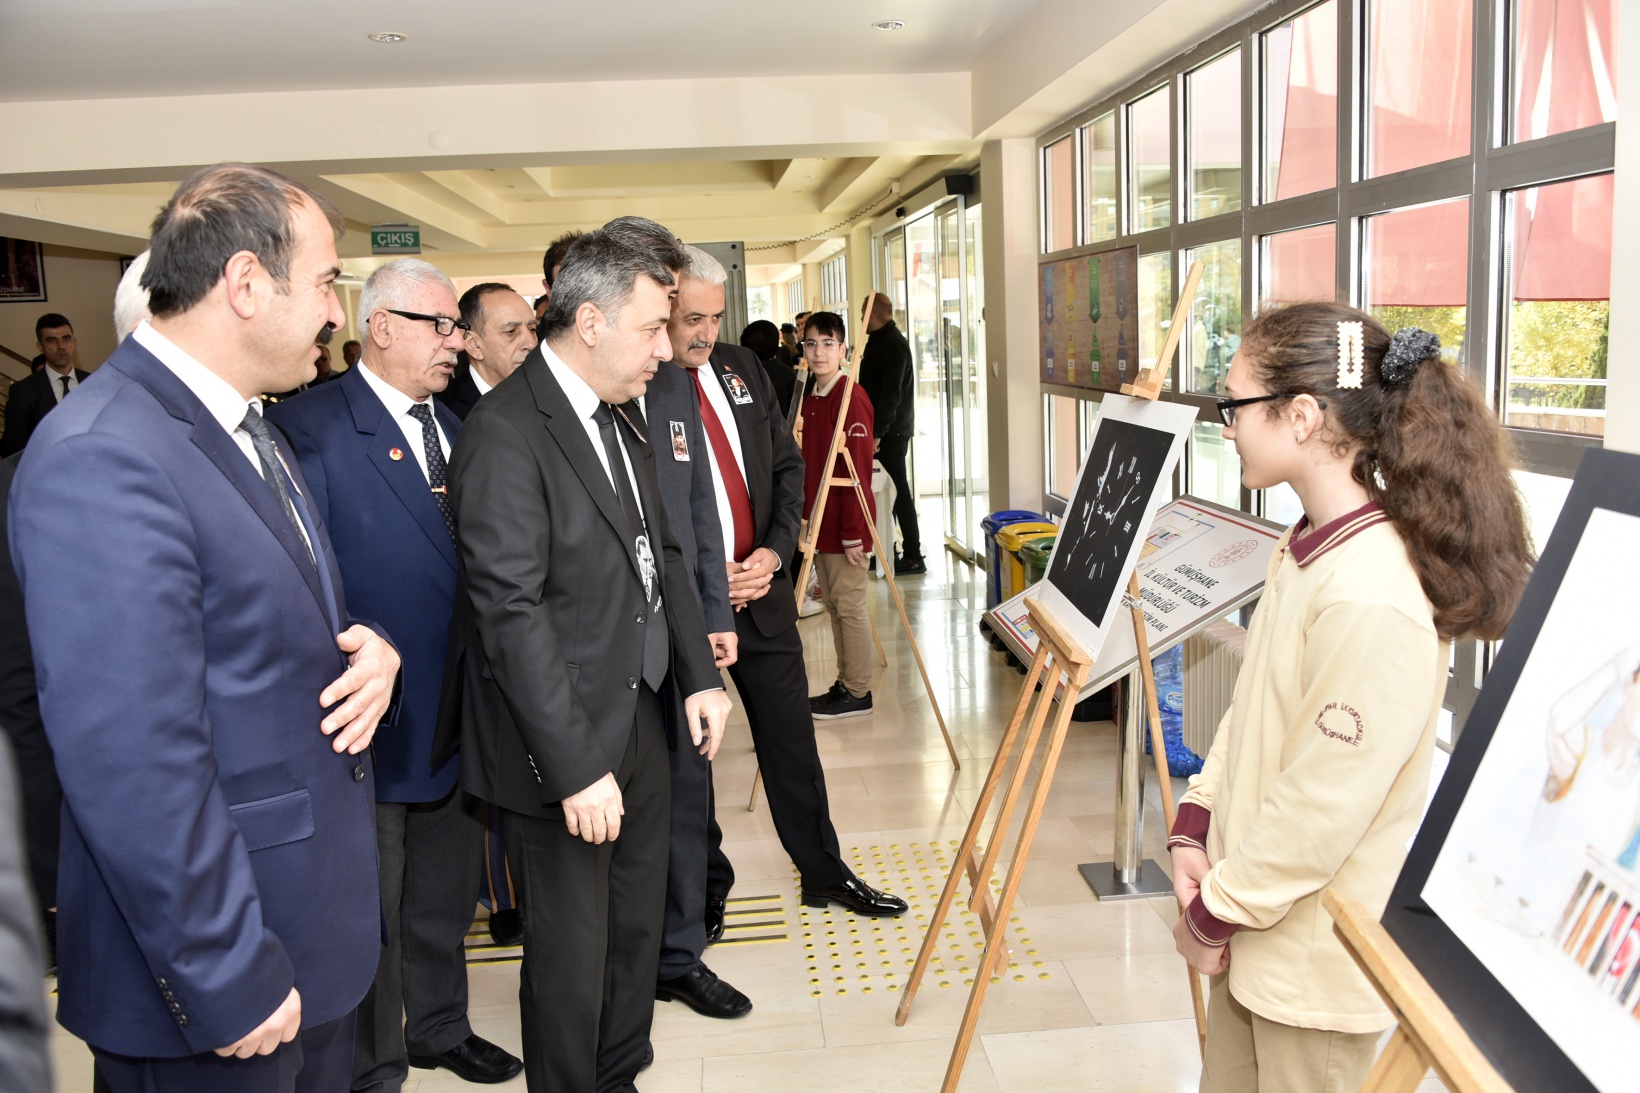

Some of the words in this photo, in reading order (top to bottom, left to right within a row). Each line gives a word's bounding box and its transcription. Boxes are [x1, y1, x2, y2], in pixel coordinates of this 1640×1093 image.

[377, 232, 415, 246] ÇIKIŞ
[1144, 567, 1158, 578] İL
[1151, 573, 1178, 590] KÜLTÜR
[1171, 584, 1187, 595] VE
[1180, 589, 1211, 609] TURİZM
[1174, 563, 1219, 589] GÜMÜŞHANE
